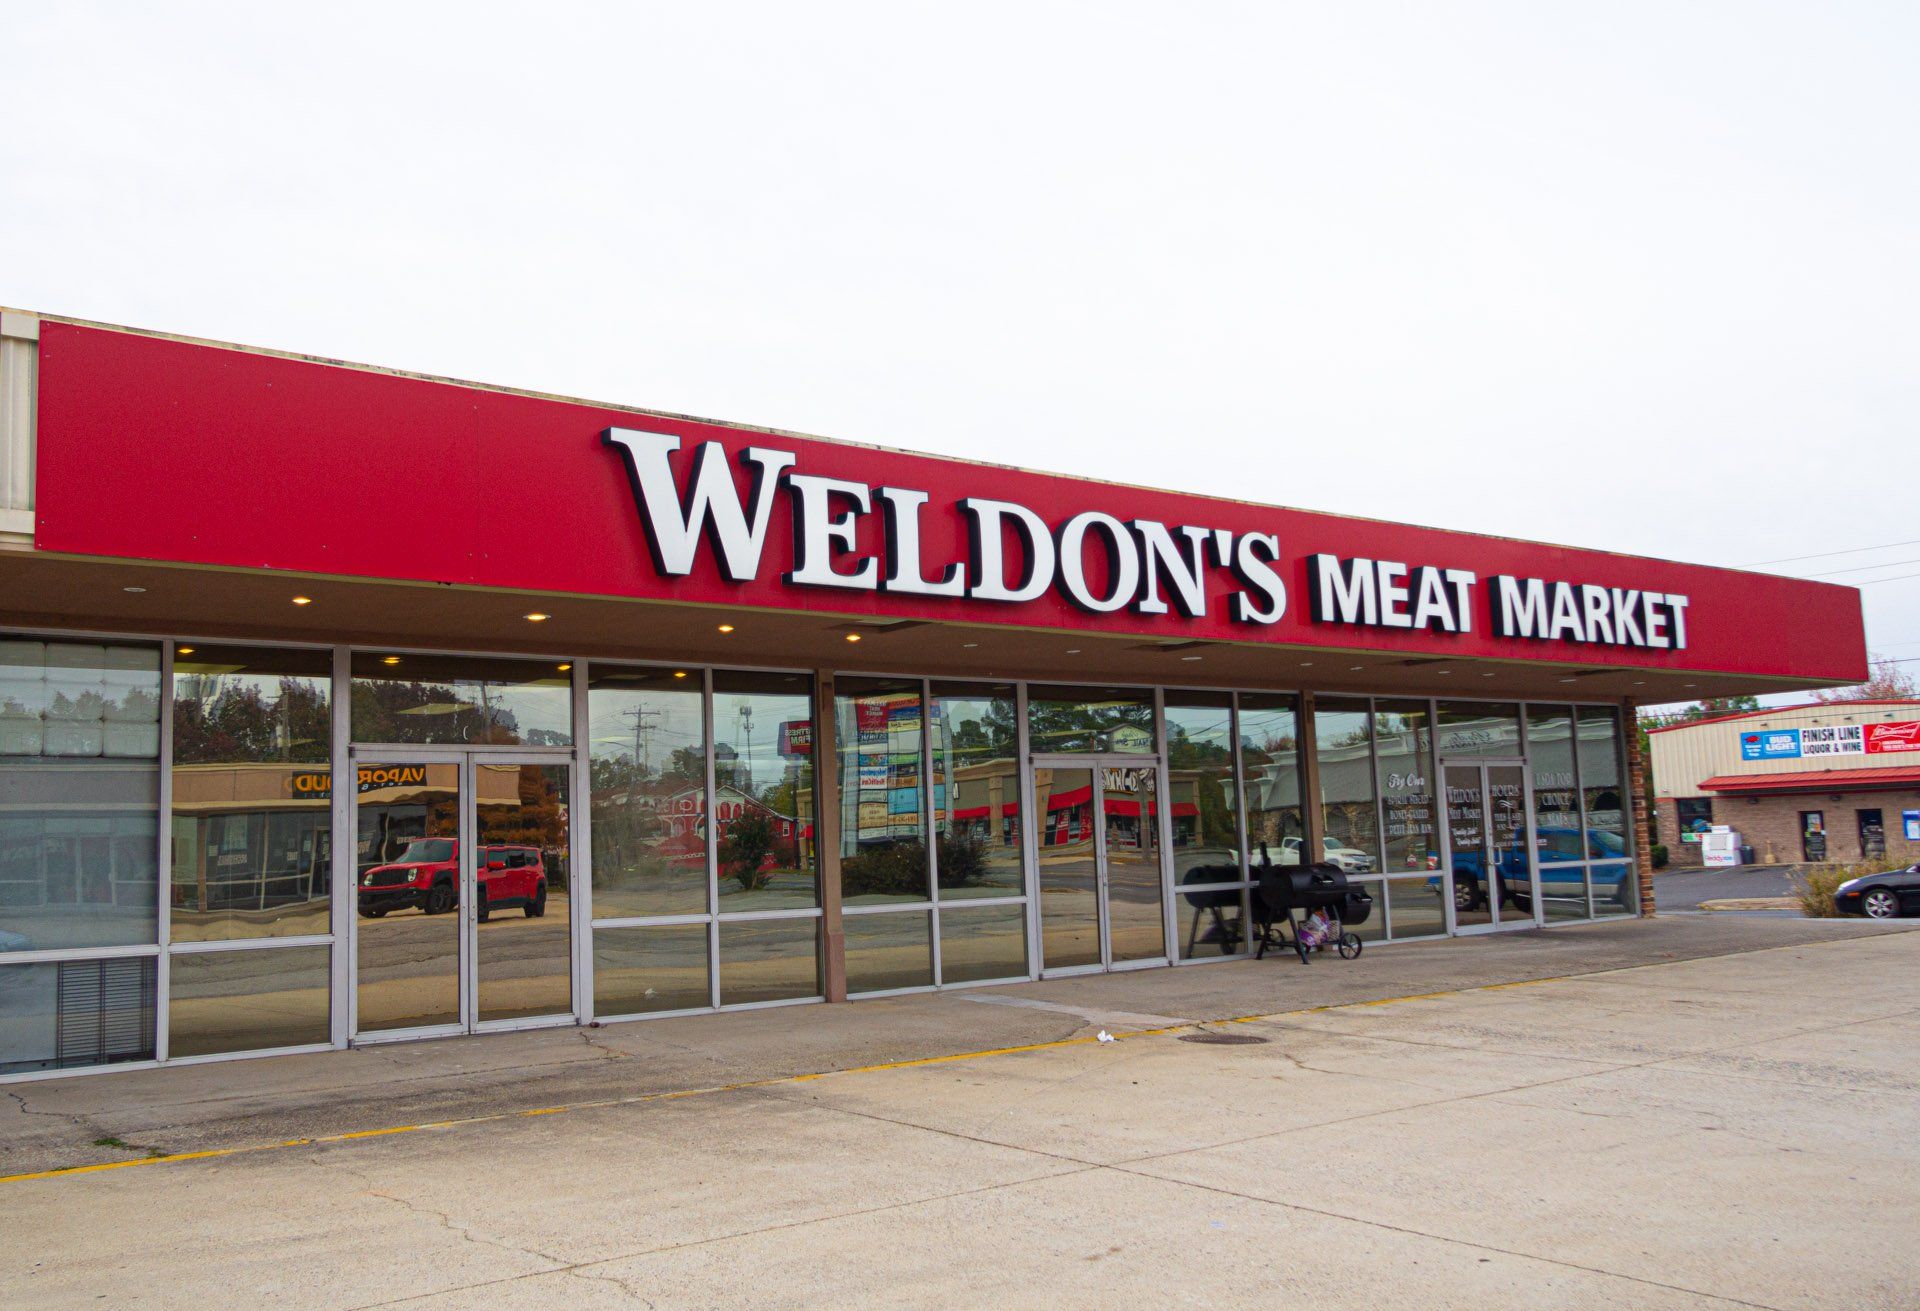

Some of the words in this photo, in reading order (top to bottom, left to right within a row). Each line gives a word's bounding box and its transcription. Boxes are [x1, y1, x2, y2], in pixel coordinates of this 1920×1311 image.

[607, 427, 1287, 626] WELDON'S
[1315, 553, 1477, 633] MEAT
[1496, 574, 1689, 650] MARKET
[1769, 735, 1793, 744] BUD
[1801, 728, 1835, 743] FINISH
[1838, 726, 1860, 741] LINE
[1803, 743, 1830, 754] LIQUOR
[1833, 742, 1839, 753] &
[1842, 741, 1861, 752] WINE
